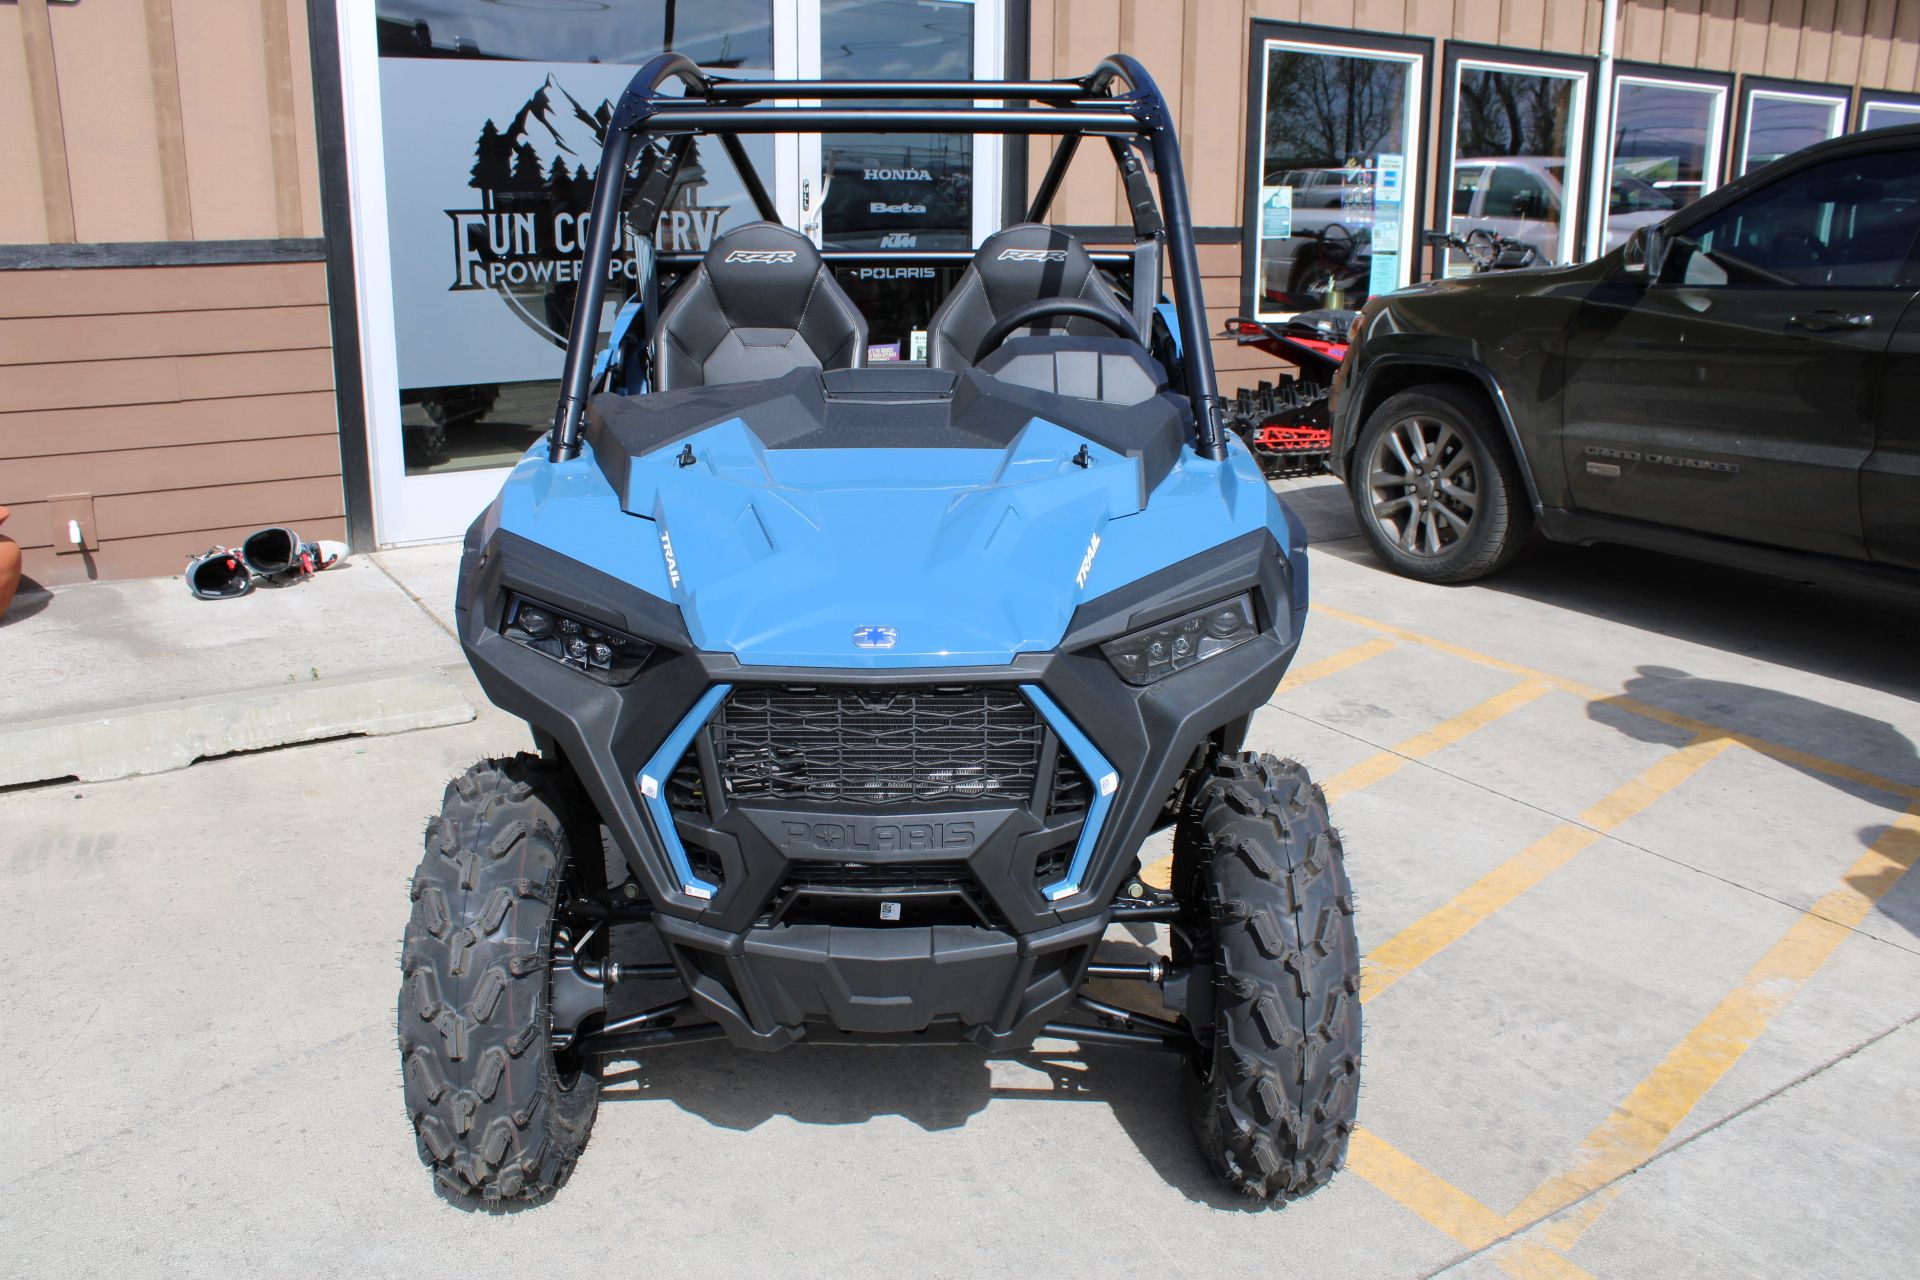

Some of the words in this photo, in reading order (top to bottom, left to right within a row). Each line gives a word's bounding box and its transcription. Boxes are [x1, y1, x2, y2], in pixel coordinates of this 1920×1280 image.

[863, 169, 932, 181] HONDA
[870, 202, 926, 213] Beta
[880, 233, 917, 248] KTM
[453, 212, 537, 286] FUN
[998, 248, 1067, 262] RZR
[725, 250, 796, 264] RZR
[860, 267, 936, 280] POLARIS
[661, 531, 680, 588] TRAIL
[1076, 532, 1100, 590] TRAIL
[780, 821, 975, 851] POLARIS
